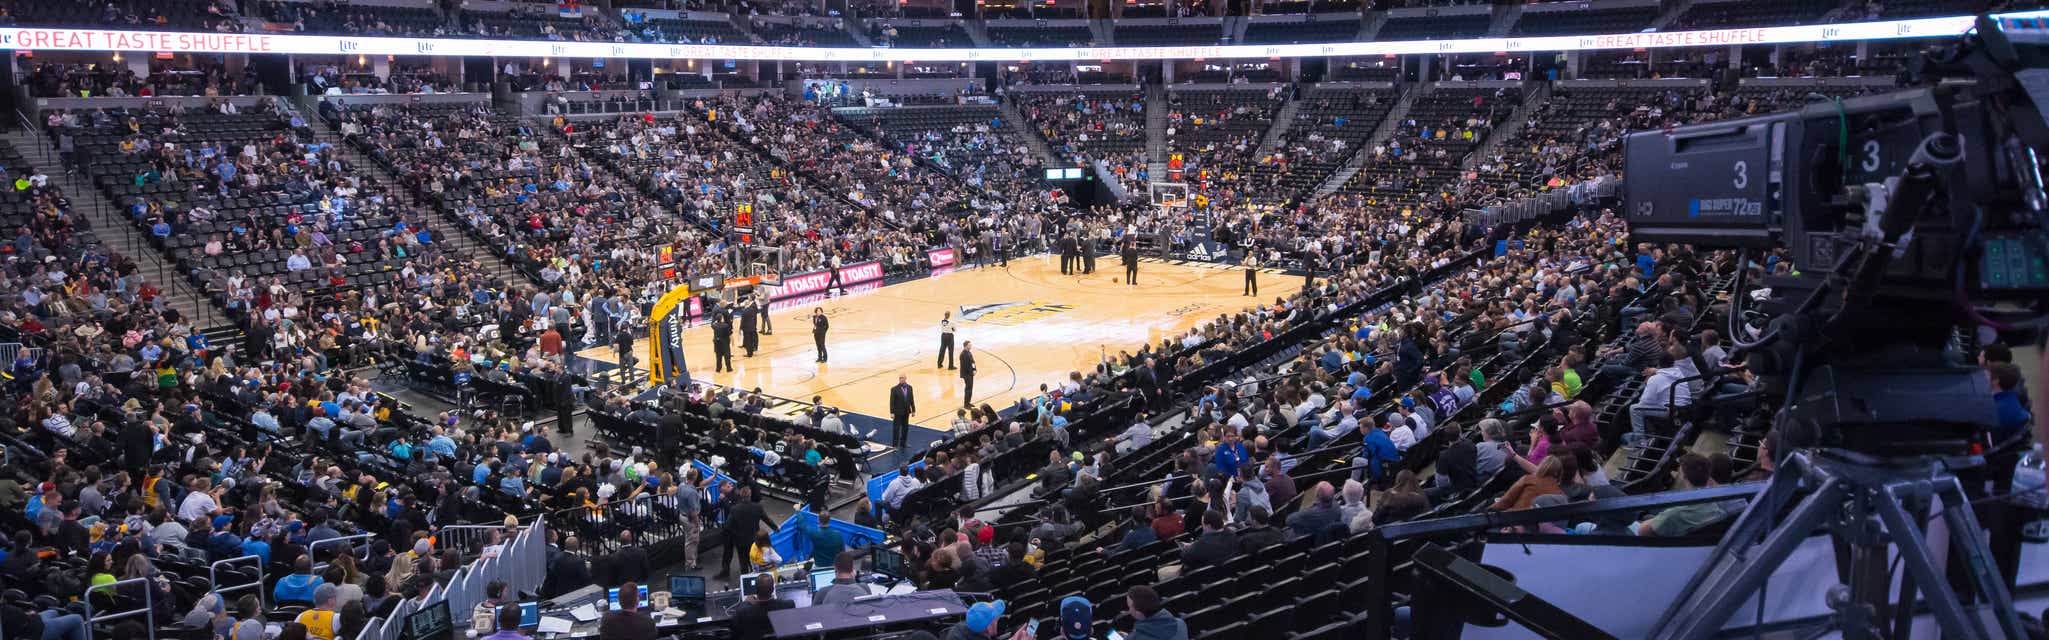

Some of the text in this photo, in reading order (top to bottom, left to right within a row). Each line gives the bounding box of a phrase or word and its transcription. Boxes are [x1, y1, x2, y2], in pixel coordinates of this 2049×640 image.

[1597, 35, 1642, 47] GREAT
[1648, 32, 1692, 45] TASTE
[1699, 29, 1766, 44] SHUFFLE
[1822, 28, 1840, 38] Lite
[1896, 23, 1912, 35] Lite
[17, 30, 95, 48] GREAT
[104, 32, 172, 49] TASTE
[179, 34, 271, 51] SHUFFLE
[339, 40, 358, 52] Lite
[417, 41, 434, 53] Lite
[1862, 139, 1881, 173] 3
[1733, 160, 1748, 190] 3
[1187, 252, 1211, 262] adidas
[846, 264, 880, 282] TOASTY
[667, 313, 680, 349] xfinity
